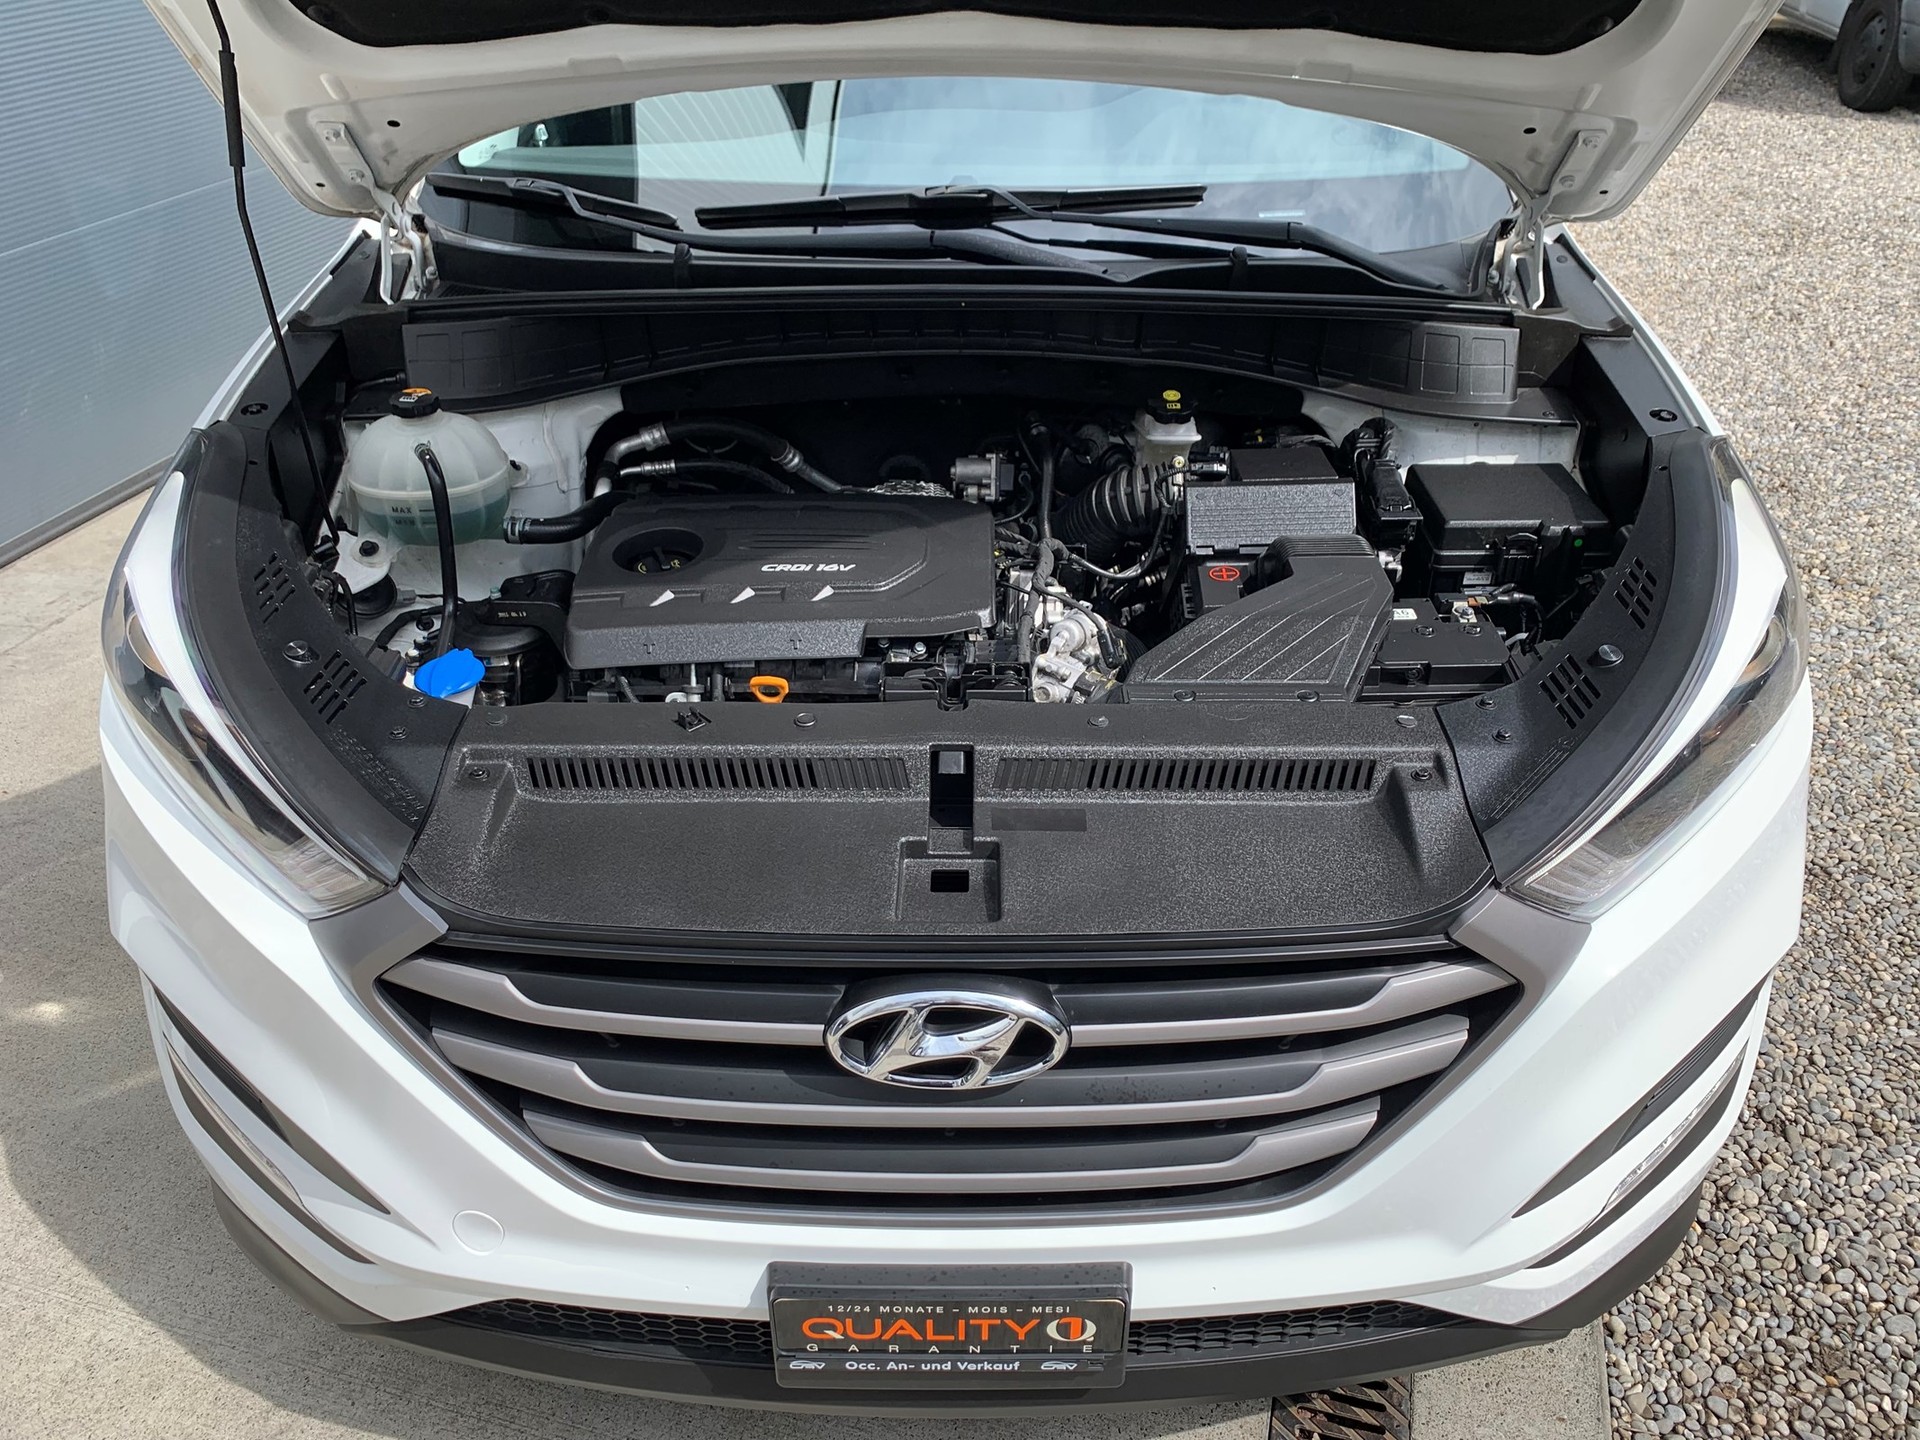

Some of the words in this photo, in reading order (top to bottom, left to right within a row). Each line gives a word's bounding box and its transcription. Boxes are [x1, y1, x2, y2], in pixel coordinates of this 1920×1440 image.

[816, 563, 856, 572] 16V
[827, 1304, 871, 1313] 12/24
[879, 1305, 944, 1314] MONATE
[968, 1306, 1008, 1314] MOIS
[1031, 1305, 1070, 1314] MESI
[802, 1317, 1041, 1341] QUALITY
[806, 1343, 1093, 1354] GARANTIE
[845, 1361, 881, 1371] Occ.
[886, 1361, 916, 1371] An-
[921, 1361, 952, 1371] und
[956, 1361, 1020, 1371] Verkauf
